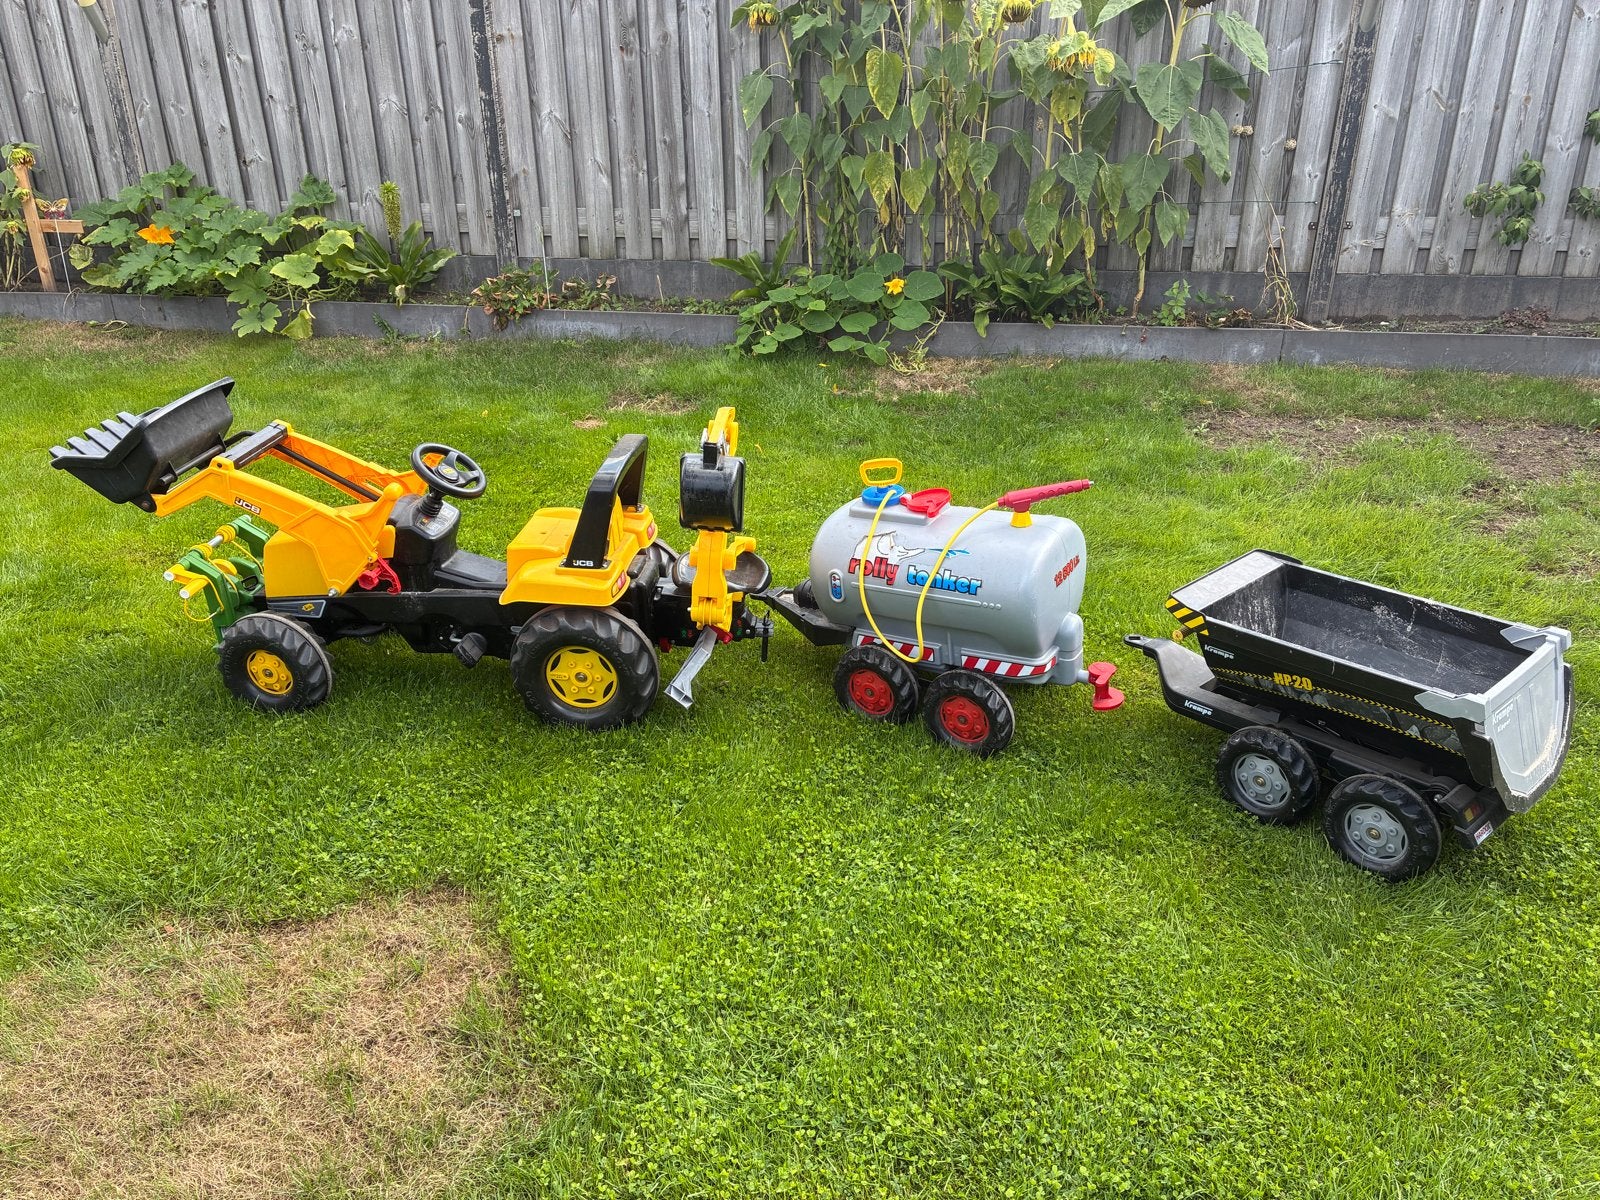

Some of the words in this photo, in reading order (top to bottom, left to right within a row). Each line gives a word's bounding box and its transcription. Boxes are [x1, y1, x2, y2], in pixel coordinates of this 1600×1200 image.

[235, 497, 261, 514] JCB
[572, 559, 594, 567] JCB
[848, 555, 900, 586] rolly
[906, 564, 982, 596] tanker
[1203, 644, 1235, 660] Krampe
[1184, 699, 1214, 716] Krampe
